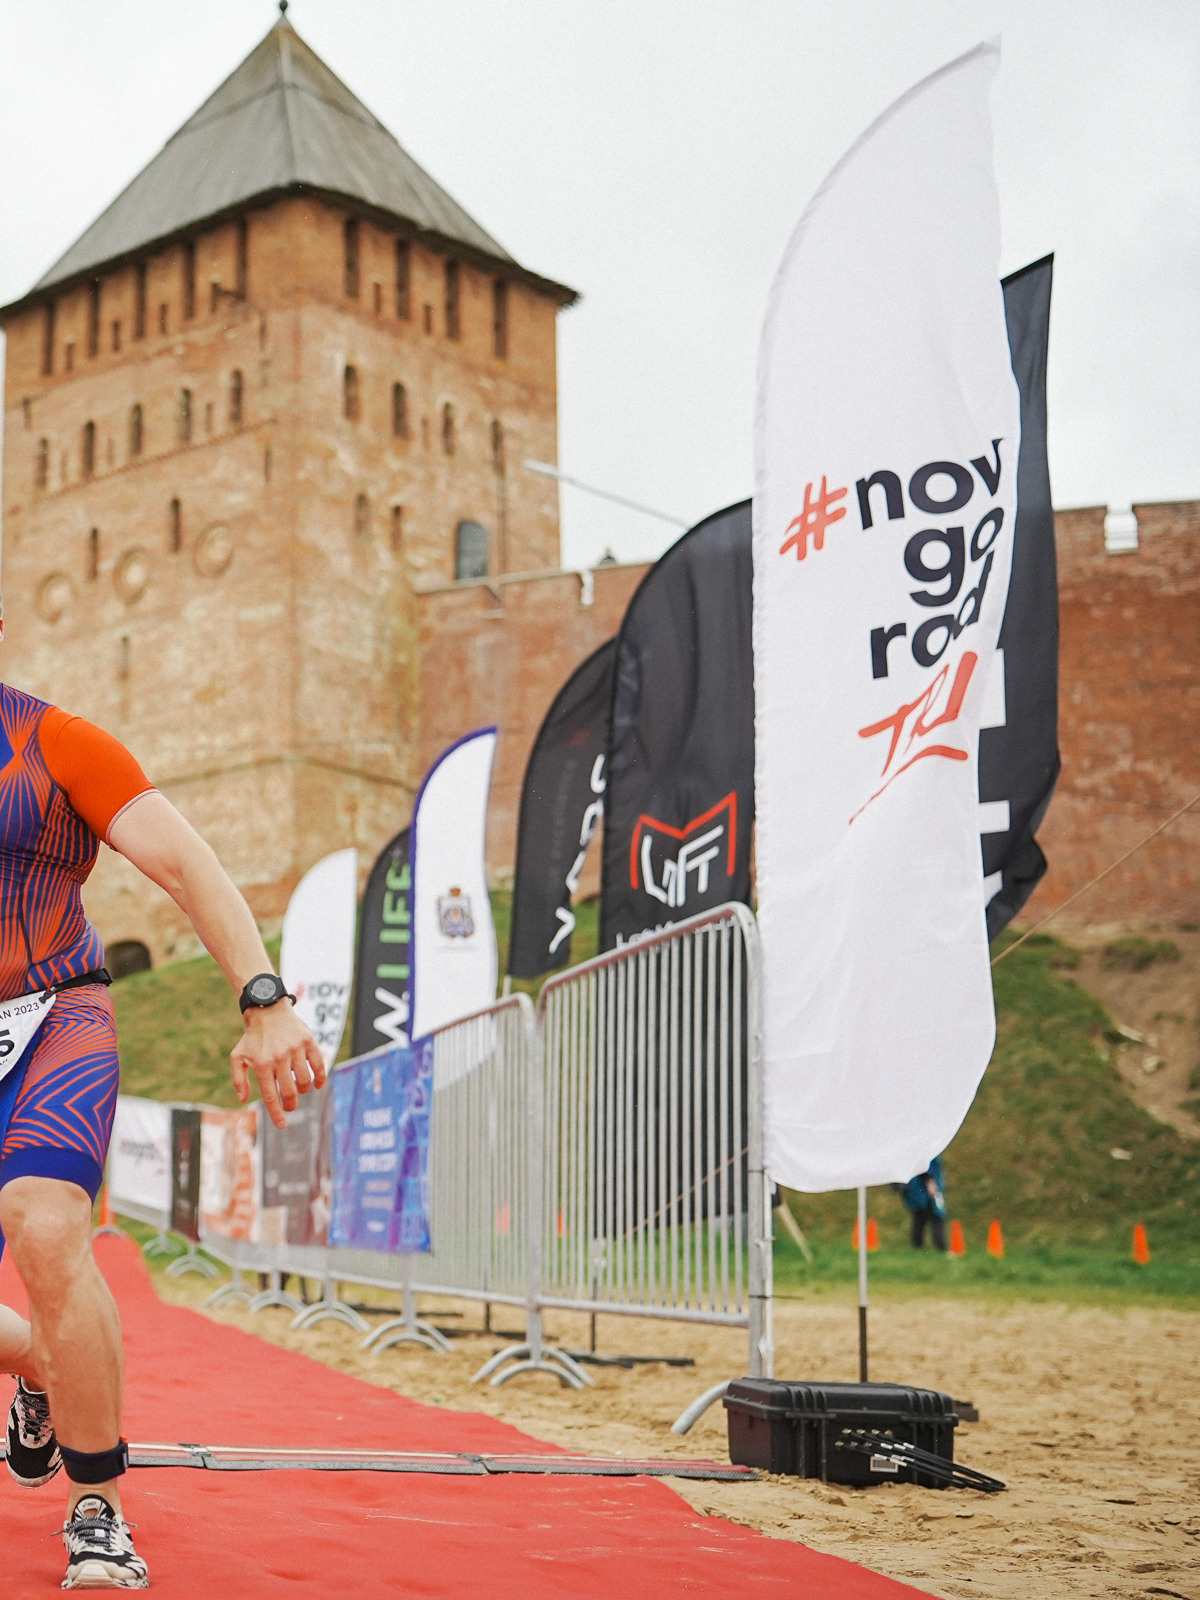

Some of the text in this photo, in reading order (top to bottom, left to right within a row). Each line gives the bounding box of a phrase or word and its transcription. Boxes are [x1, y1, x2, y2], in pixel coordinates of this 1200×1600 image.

[779, 438, 1003, 561] #nov
[904, 507, 1004, 607] go
[870, 550, 995, 679] rod
[14, 1002, 40, 1015] 2023
